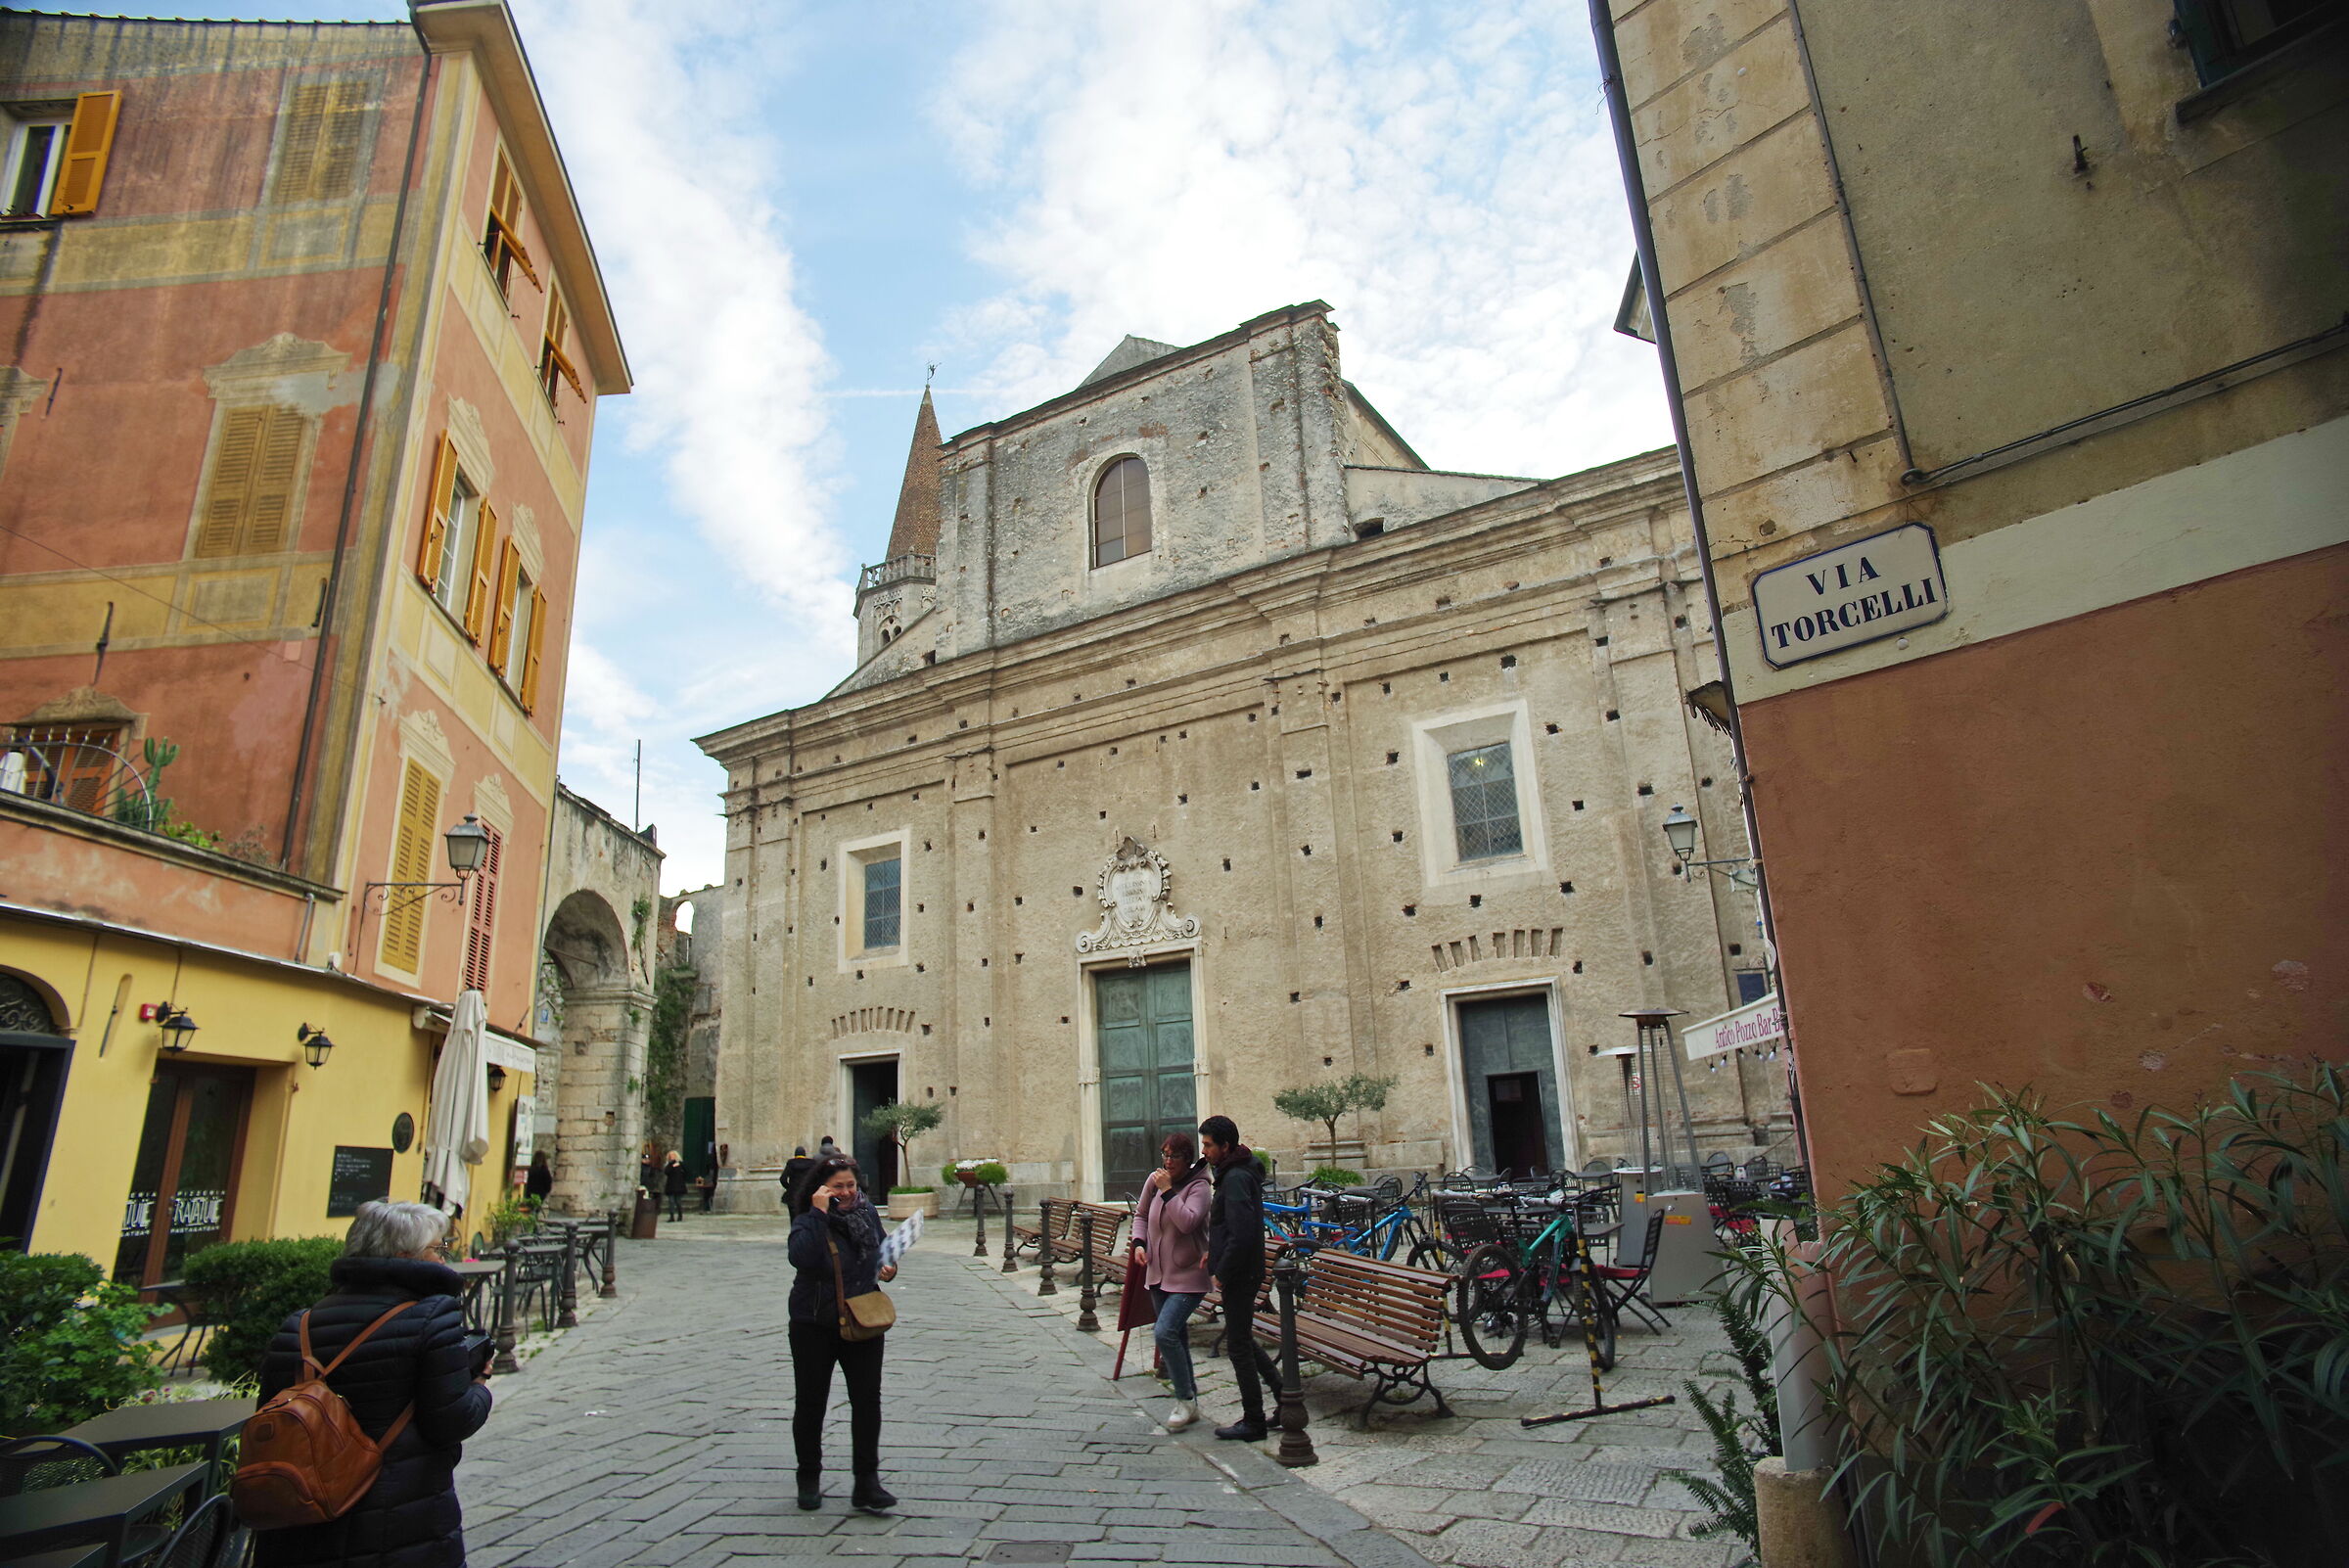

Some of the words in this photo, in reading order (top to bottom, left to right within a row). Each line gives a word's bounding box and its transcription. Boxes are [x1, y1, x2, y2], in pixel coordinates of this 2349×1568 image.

[1806, 556, 1881, 596] VIA
[1770, 576, 1938, 649] TORCELLI
[1715, 1025, 1735, 1049] Antico
[1734, 1020, 1758, 1043] Pozzo
[1756, 1013, 1772, 1037] Bar
